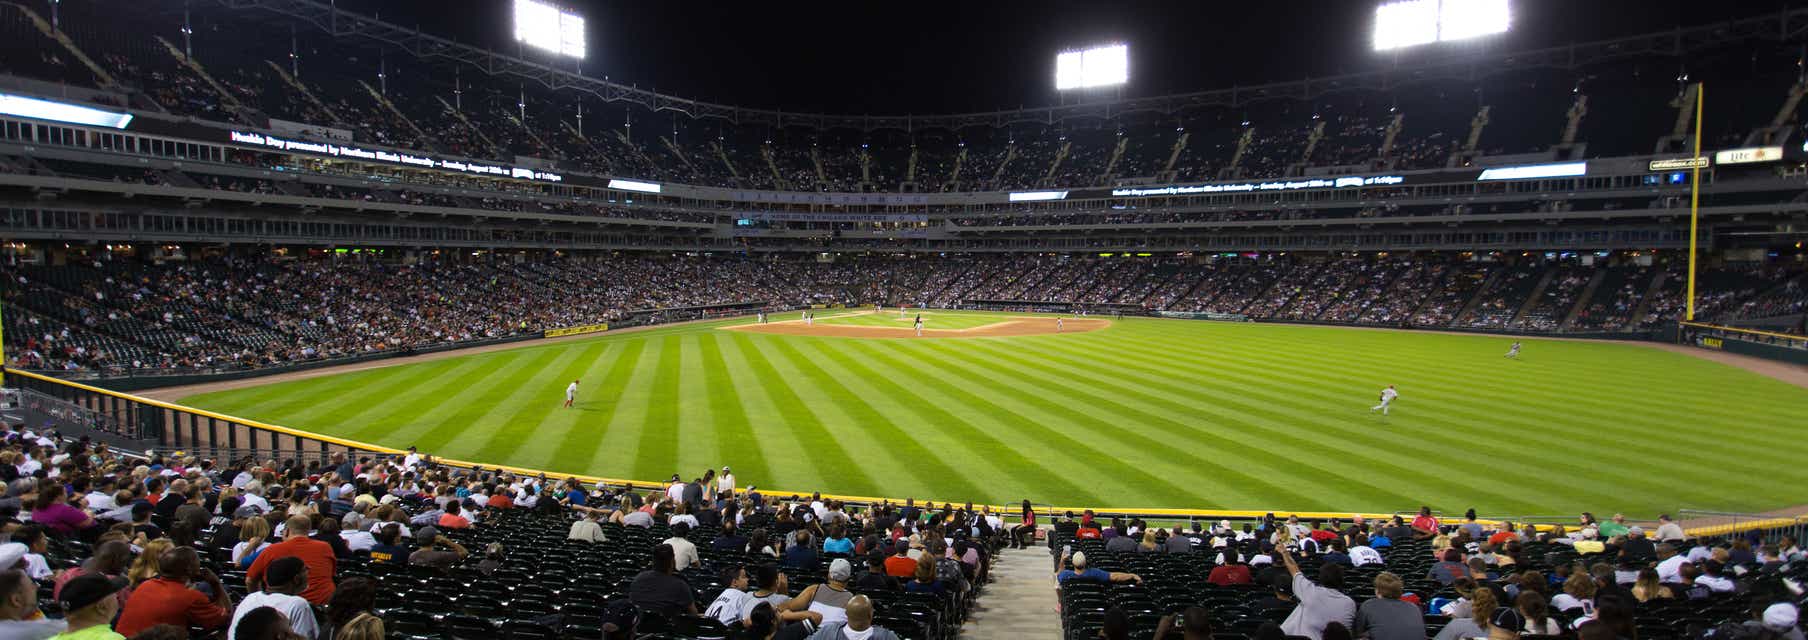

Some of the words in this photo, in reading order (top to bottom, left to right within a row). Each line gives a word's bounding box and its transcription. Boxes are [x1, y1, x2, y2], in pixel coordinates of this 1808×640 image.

[232, 132, 264, 144] Huskie
[266, 136, 285, 148] Day
[286, 142, 327, 152] presented
[329, 145, 339, 155] by
[341, 147, 375, 158] Northern
[376, 152, 400, 161] Illinois
